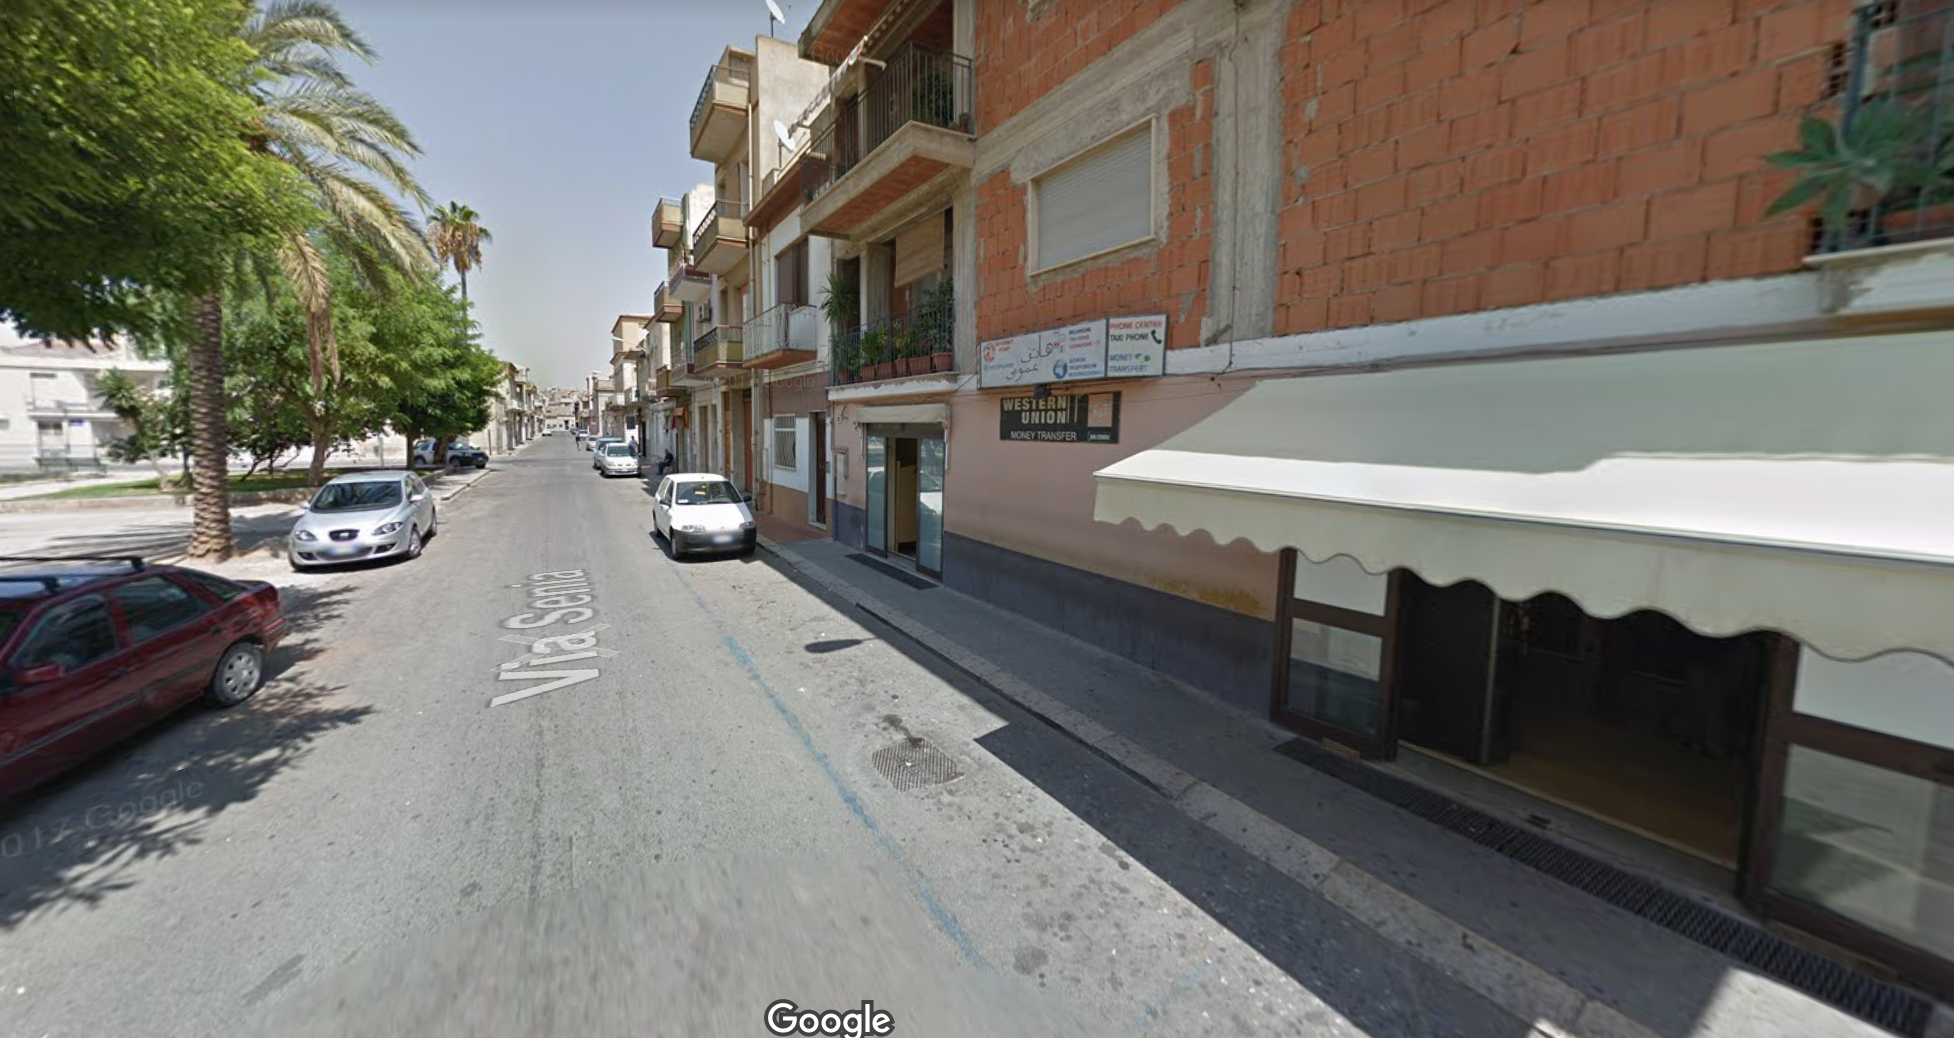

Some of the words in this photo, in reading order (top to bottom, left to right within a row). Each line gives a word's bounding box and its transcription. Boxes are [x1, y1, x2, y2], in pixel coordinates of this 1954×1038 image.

[1125, 332, 1149, 341] PHONE
[1110, 353, 1134, 361] MONEY
[1003, 396, 1067, 411] WESTERN
[1021, 410, 1066, 424] UNION
[1010, 430, 1036, 440] MONEY
[1037, 431, 1077, 441] TRANSFER
